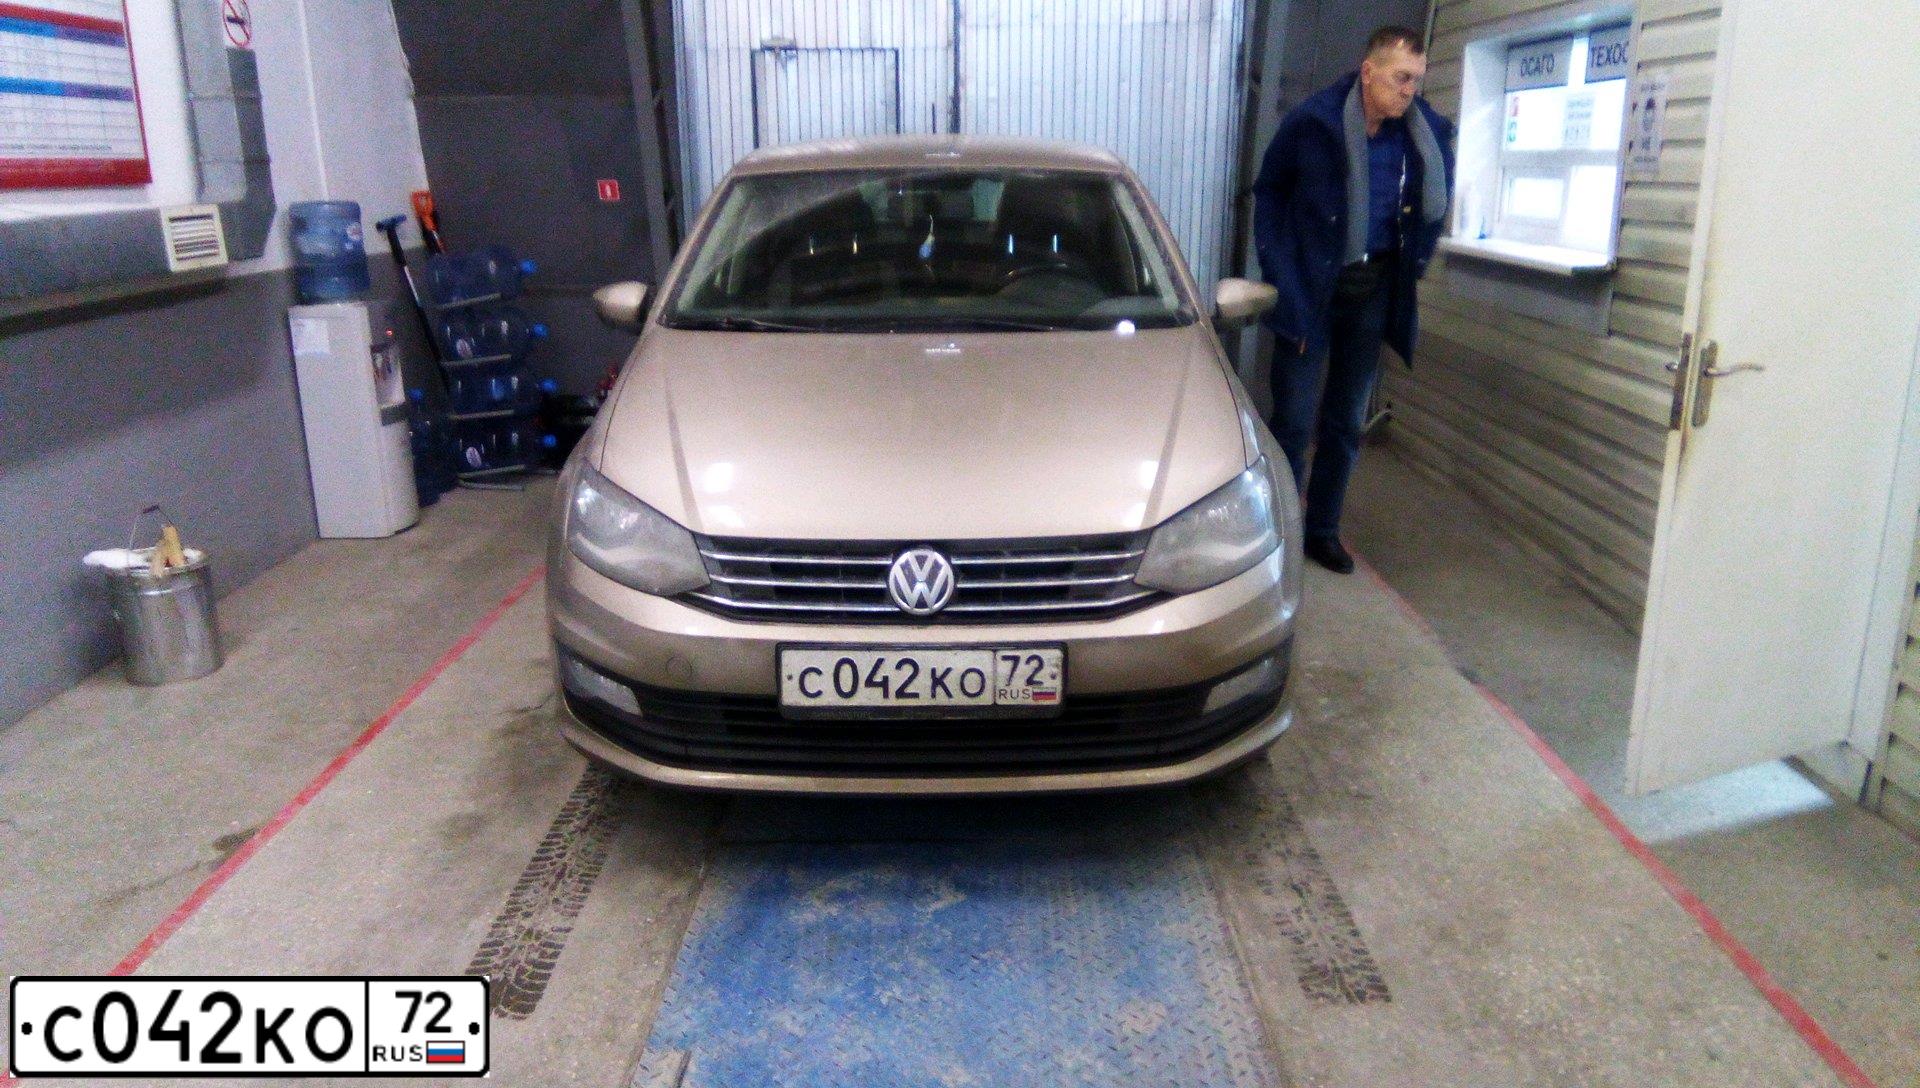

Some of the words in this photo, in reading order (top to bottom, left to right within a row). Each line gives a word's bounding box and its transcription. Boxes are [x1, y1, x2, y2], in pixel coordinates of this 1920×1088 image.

[1520, 53, 1555, 77] ОСАГО
[1000, 653, 1046, 689] 72
[997, 688, 1032, 701] RUS
